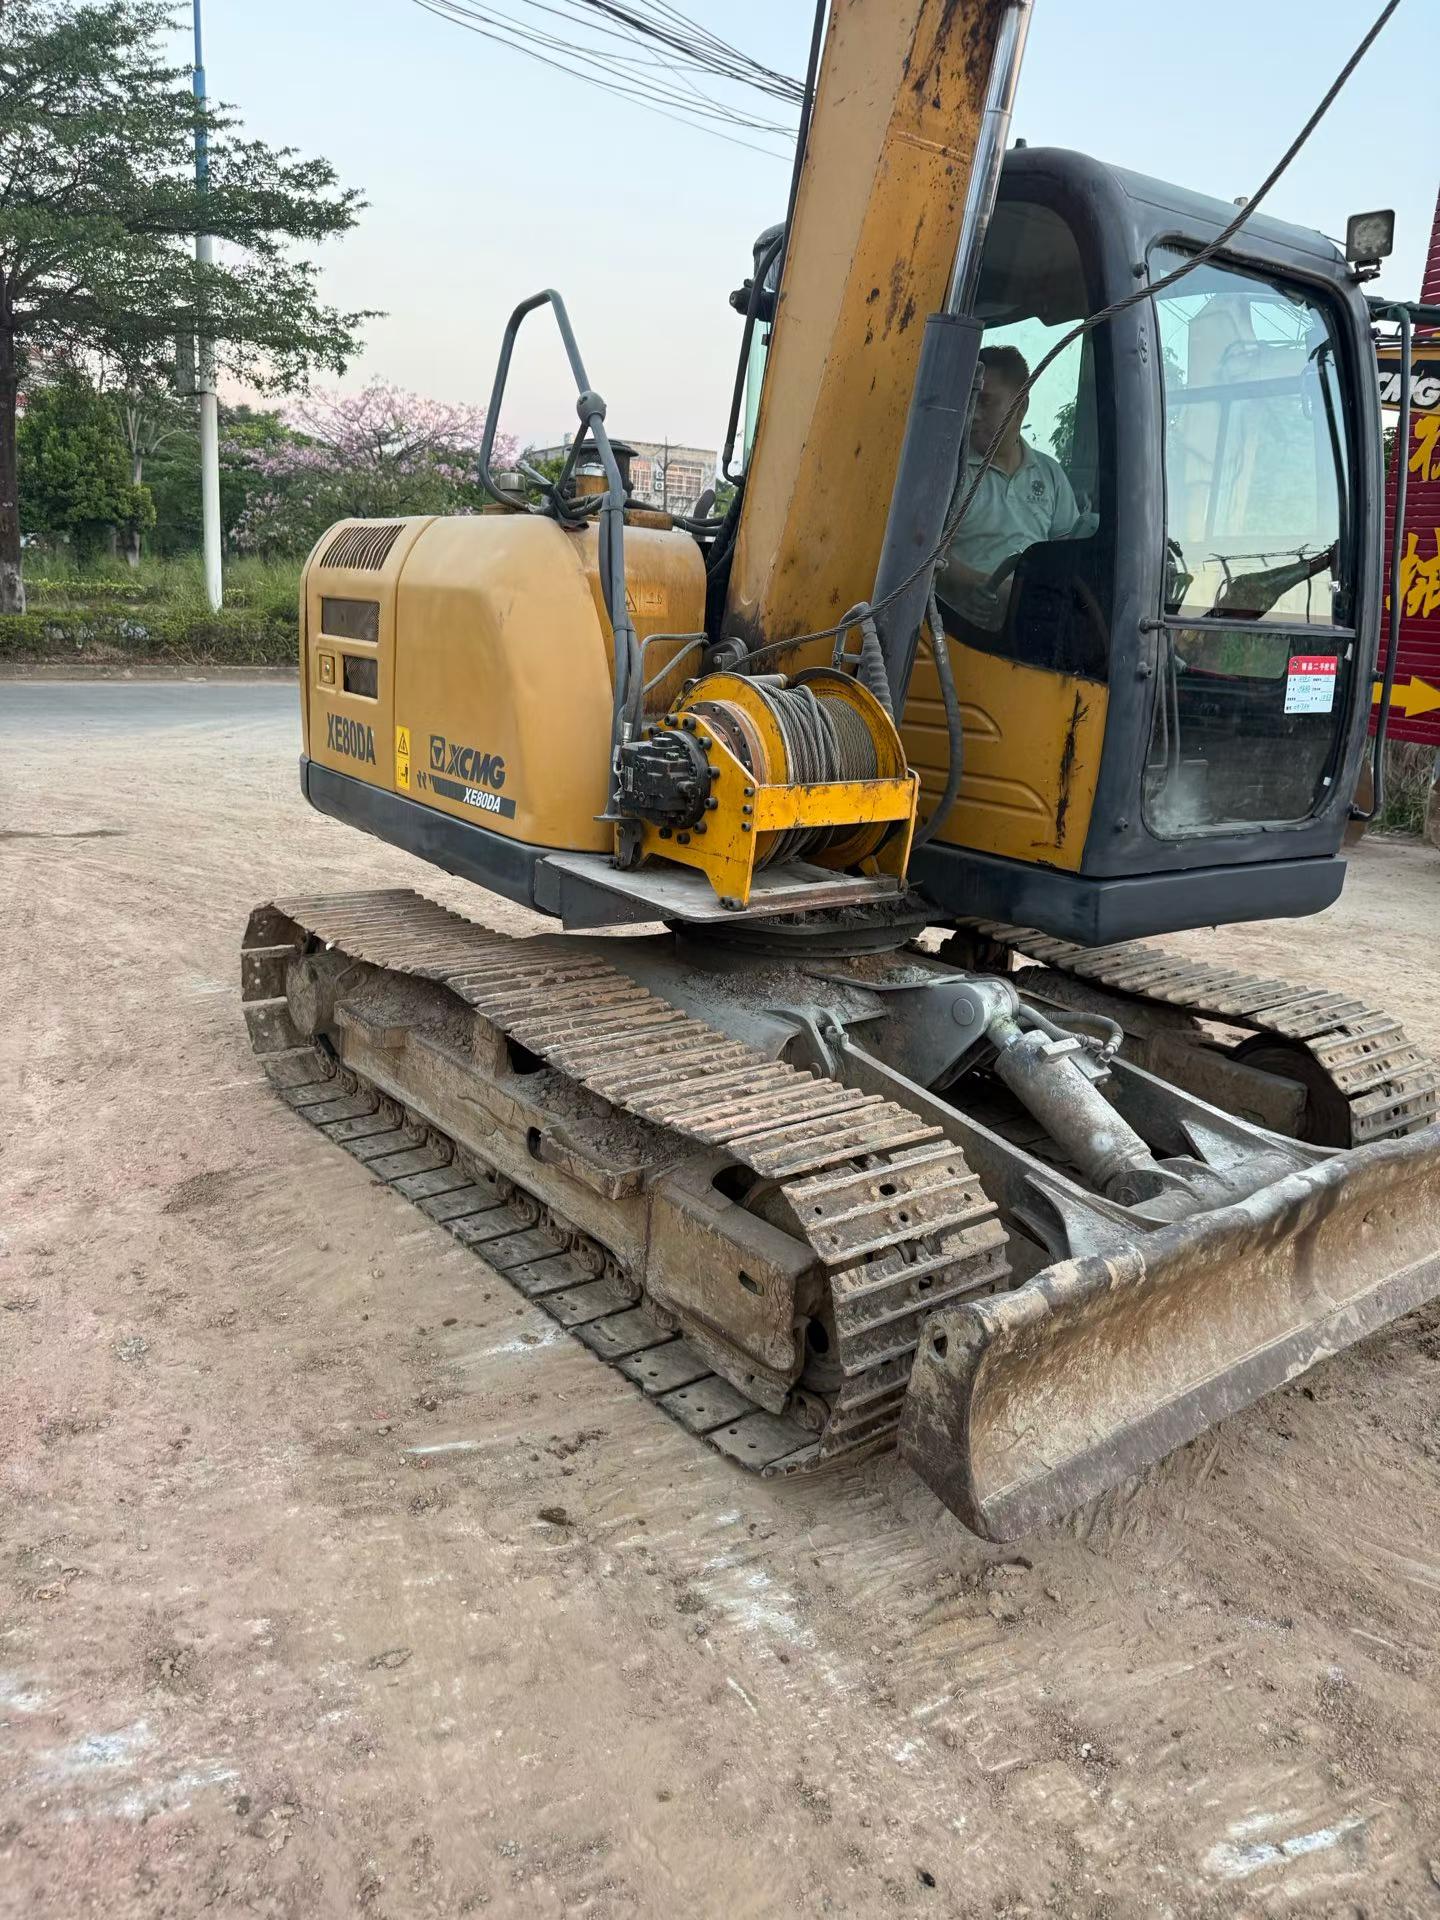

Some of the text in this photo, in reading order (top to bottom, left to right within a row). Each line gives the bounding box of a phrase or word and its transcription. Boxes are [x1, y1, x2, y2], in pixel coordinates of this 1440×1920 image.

[327, 711, 377, 766] XE80DA
[445, 743, 506, 790] XCMG
[463, 786, 501, 813] XE80DA
